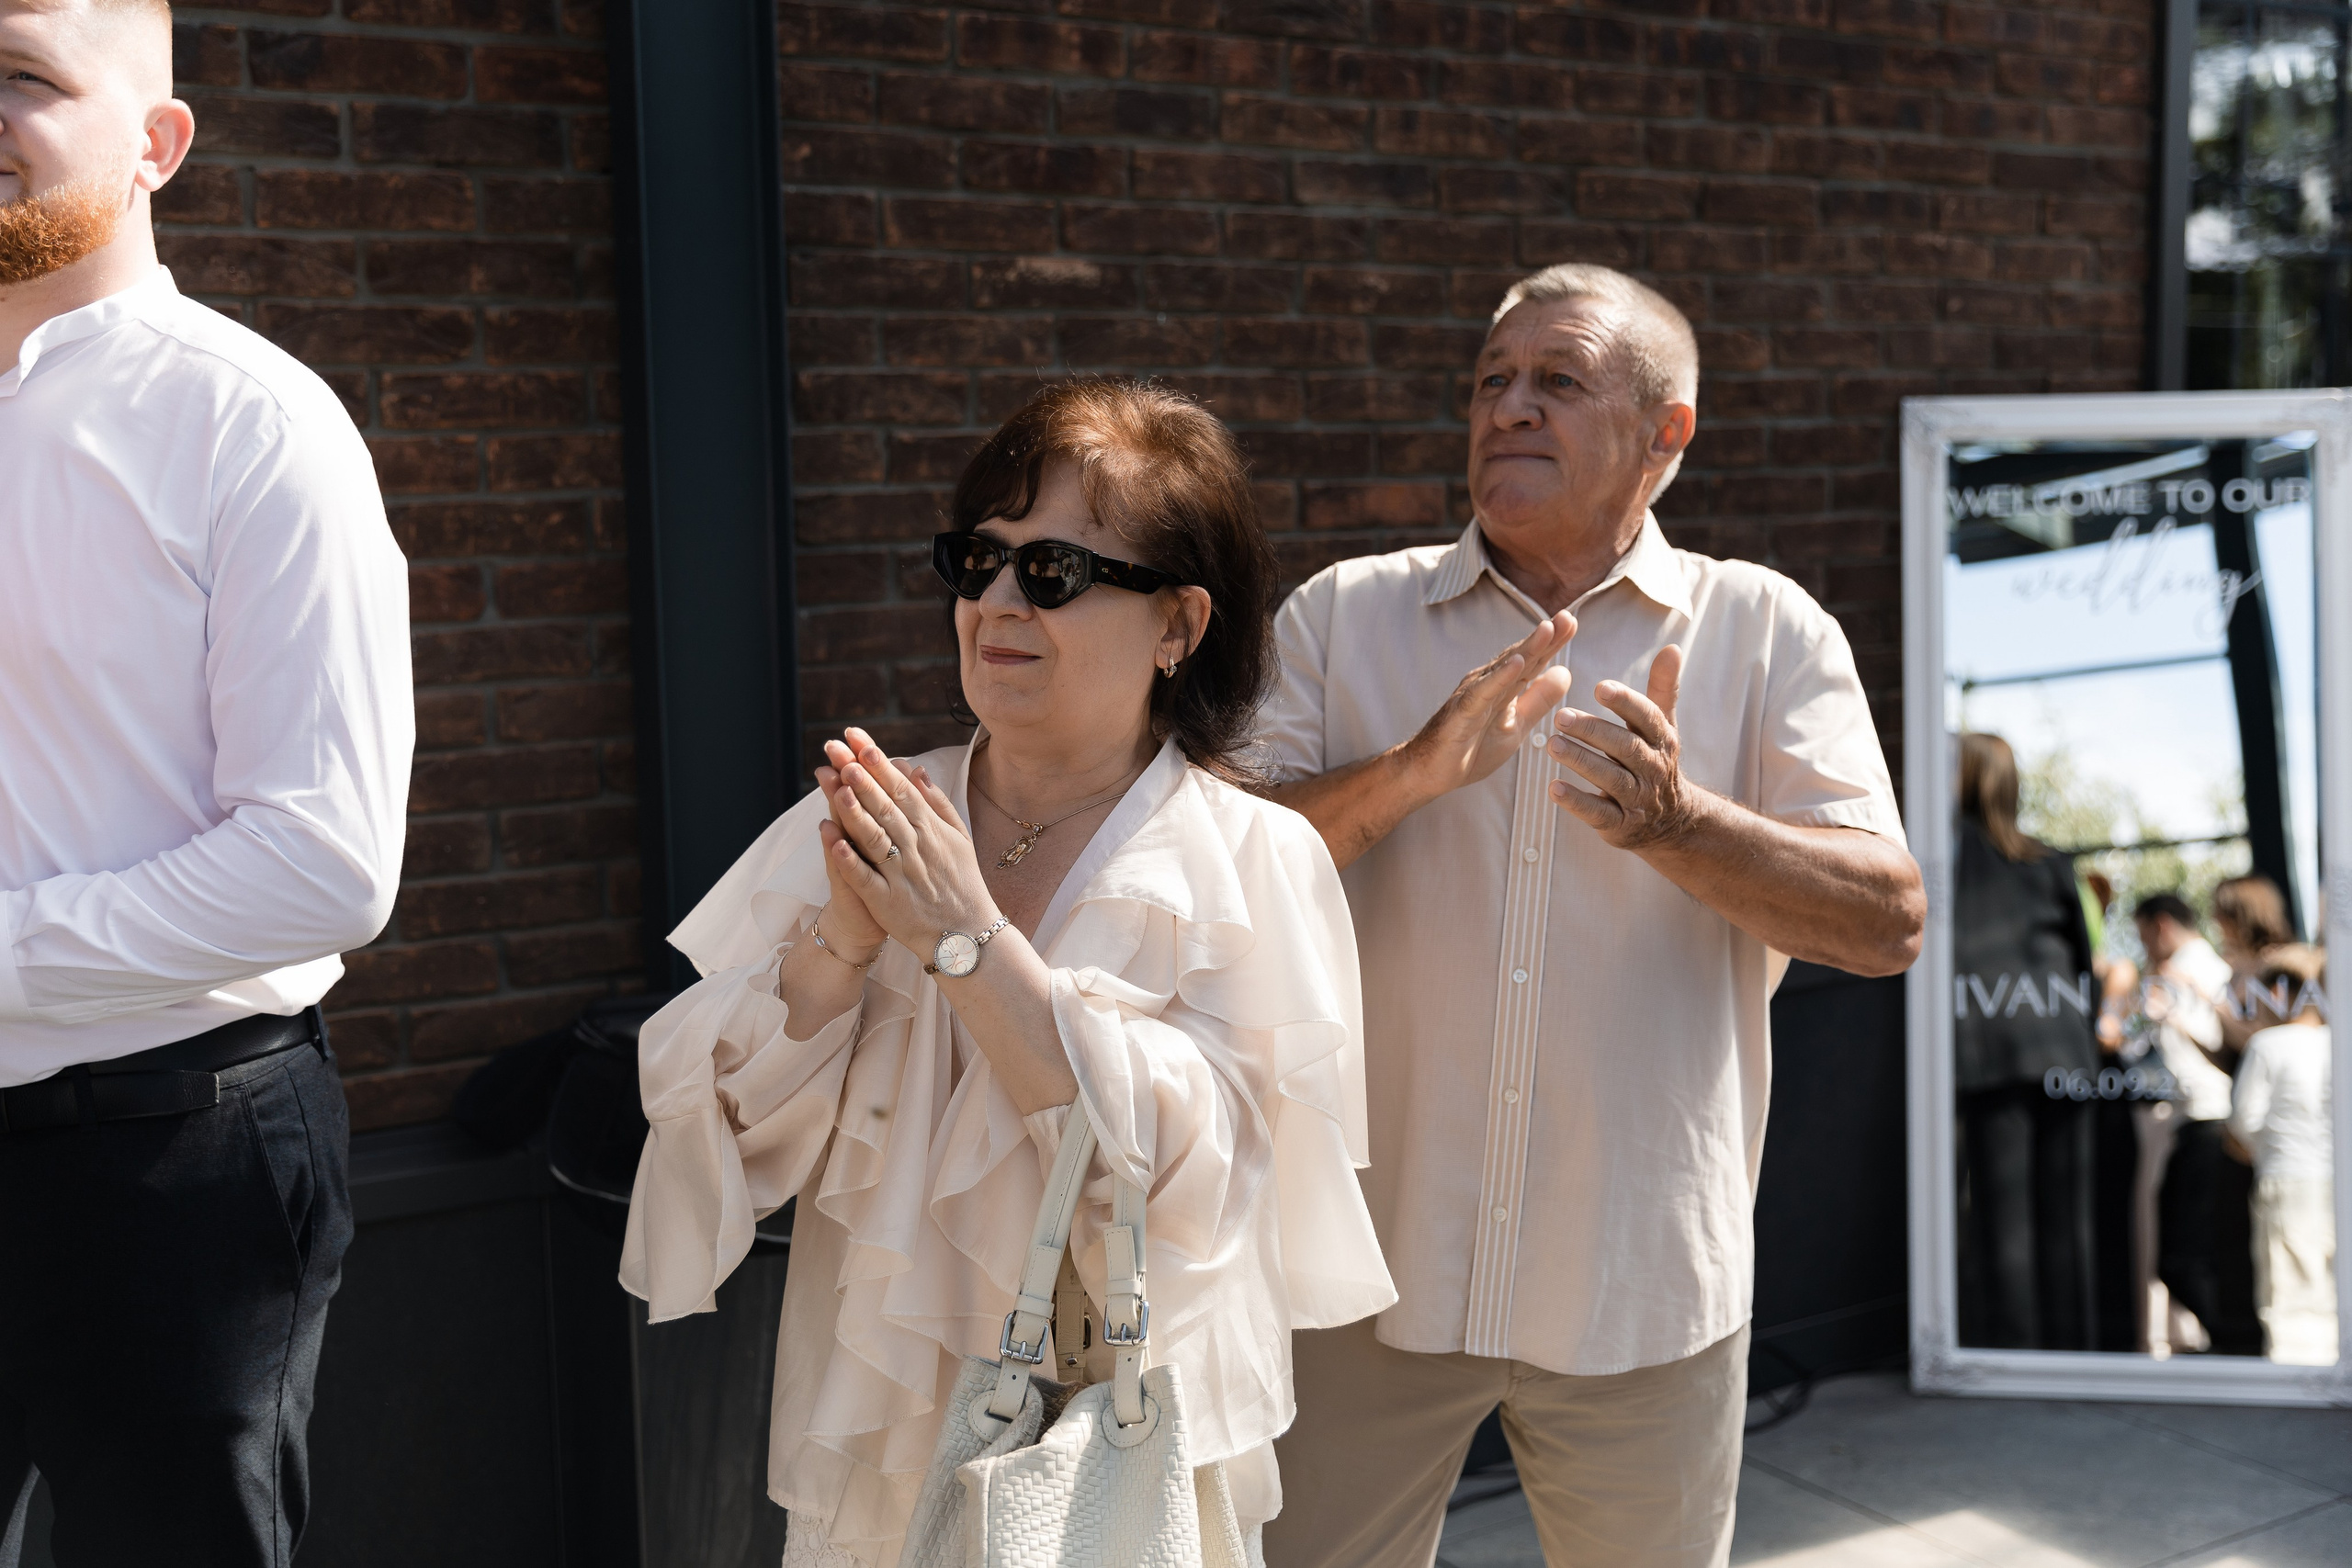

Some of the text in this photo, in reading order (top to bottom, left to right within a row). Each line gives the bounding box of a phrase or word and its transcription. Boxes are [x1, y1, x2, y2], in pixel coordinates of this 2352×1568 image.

[1946, 476, 2312, 520] WELCOME TO OUR
[1956, 971, 2091, 1019] IVAN
